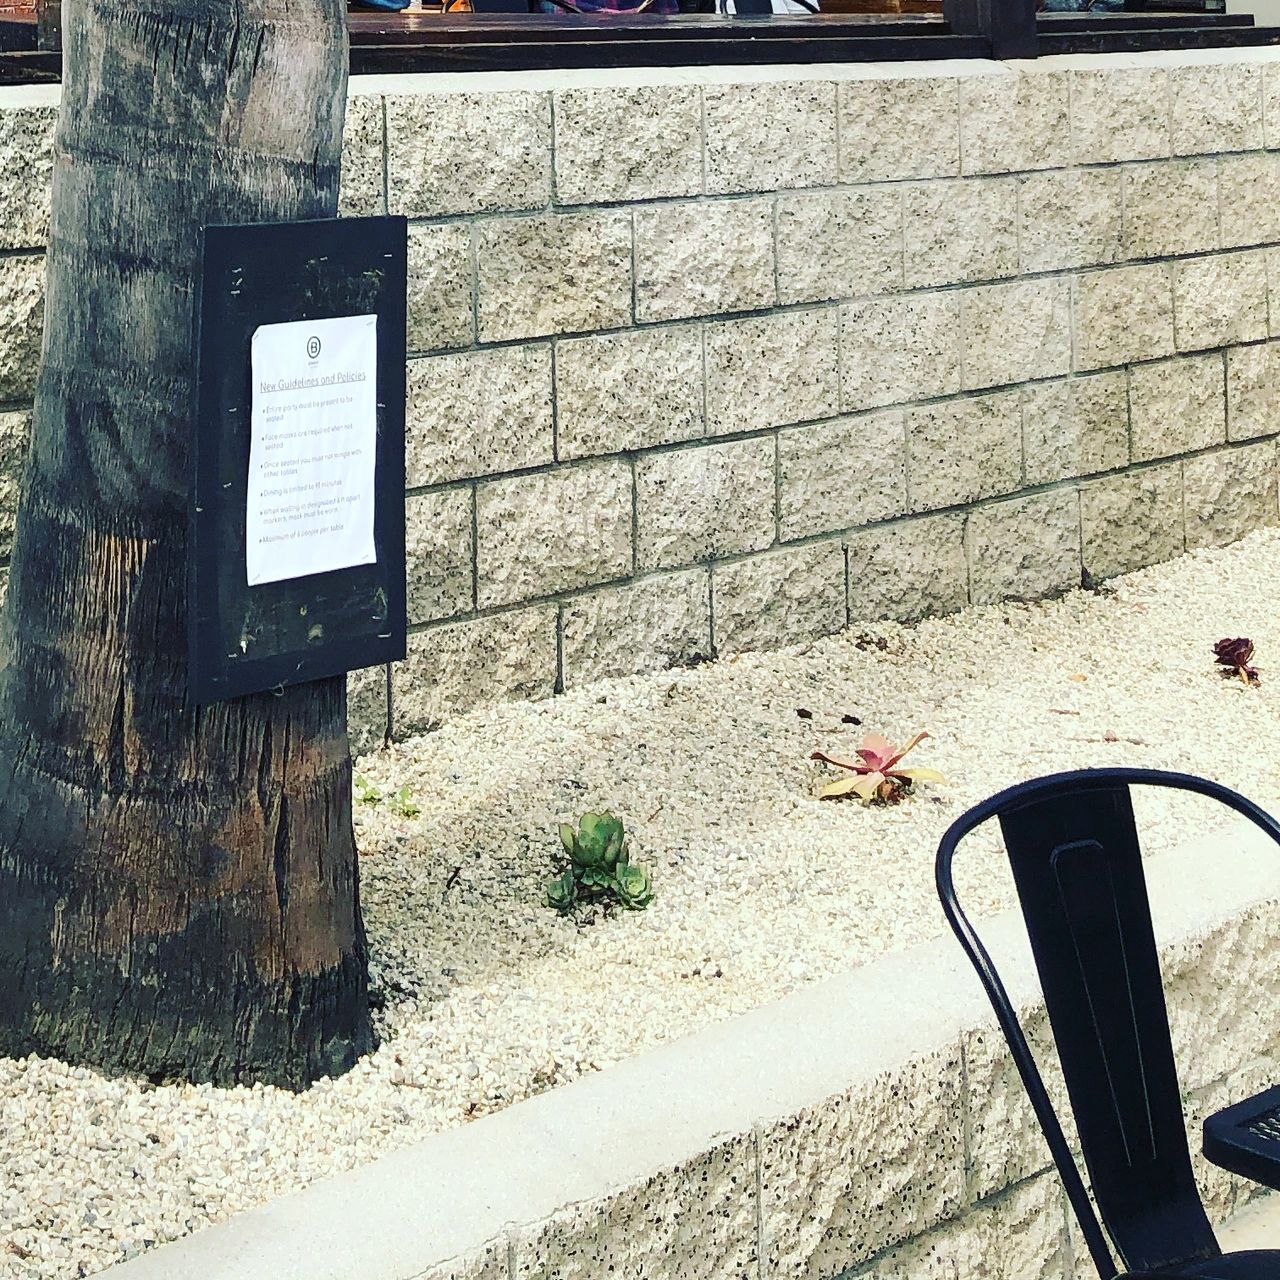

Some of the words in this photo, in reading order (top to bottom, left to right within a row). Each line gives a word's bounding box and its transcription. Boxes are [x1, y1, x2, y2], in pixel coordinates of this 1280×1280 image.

[260, 381, 276, 392] New
[278, 376, 319, 390] Guidelines
[321, 372, 335, 385] and
[337, 370, 366, 383] Policies
